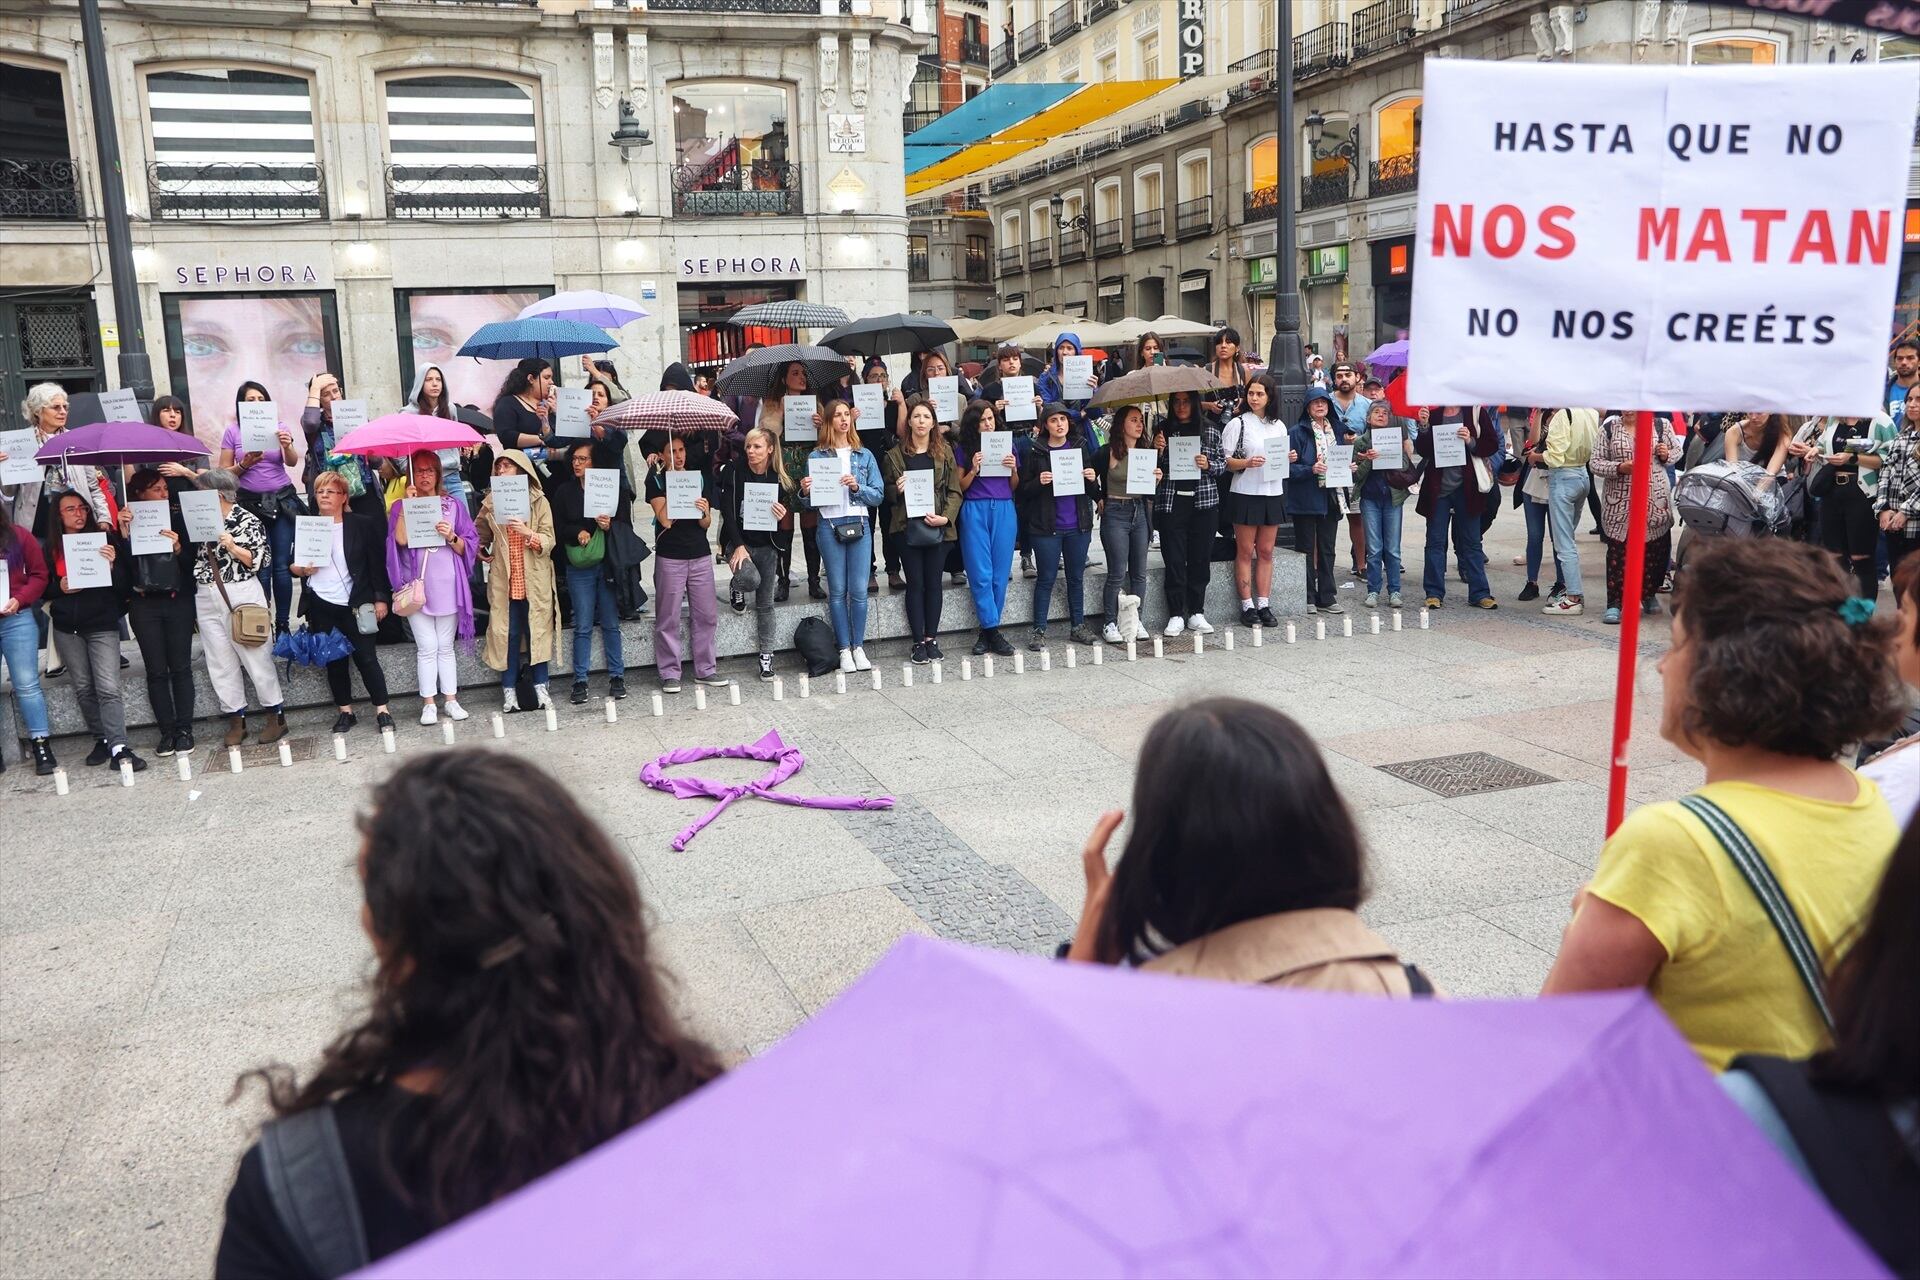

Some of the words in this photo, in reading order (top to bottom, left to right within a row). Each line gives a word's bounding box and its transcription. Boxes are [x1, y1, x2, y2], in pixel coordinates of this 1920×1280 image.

[1494, 121, 1634, 154] HASTA
[1668, 122, 1751, 161] QUE
[1787, 123, 1843, 155] NO
[1432, 203, 1577, 261] NOS
[1637, 206, 1891, 267] MATAN
[684, 256, 802, 276] SEPHORA
[1261, 263, 1274, 281] Julia
[1322, 253, 1337, 271] Julia
[176, 265, 318, 284] SEPHORA
[1468, 307, 1519, 338] NO
[1552, 309, 1635, 341] NOS
[1666, 305, 1836, 345] CREÉIS
